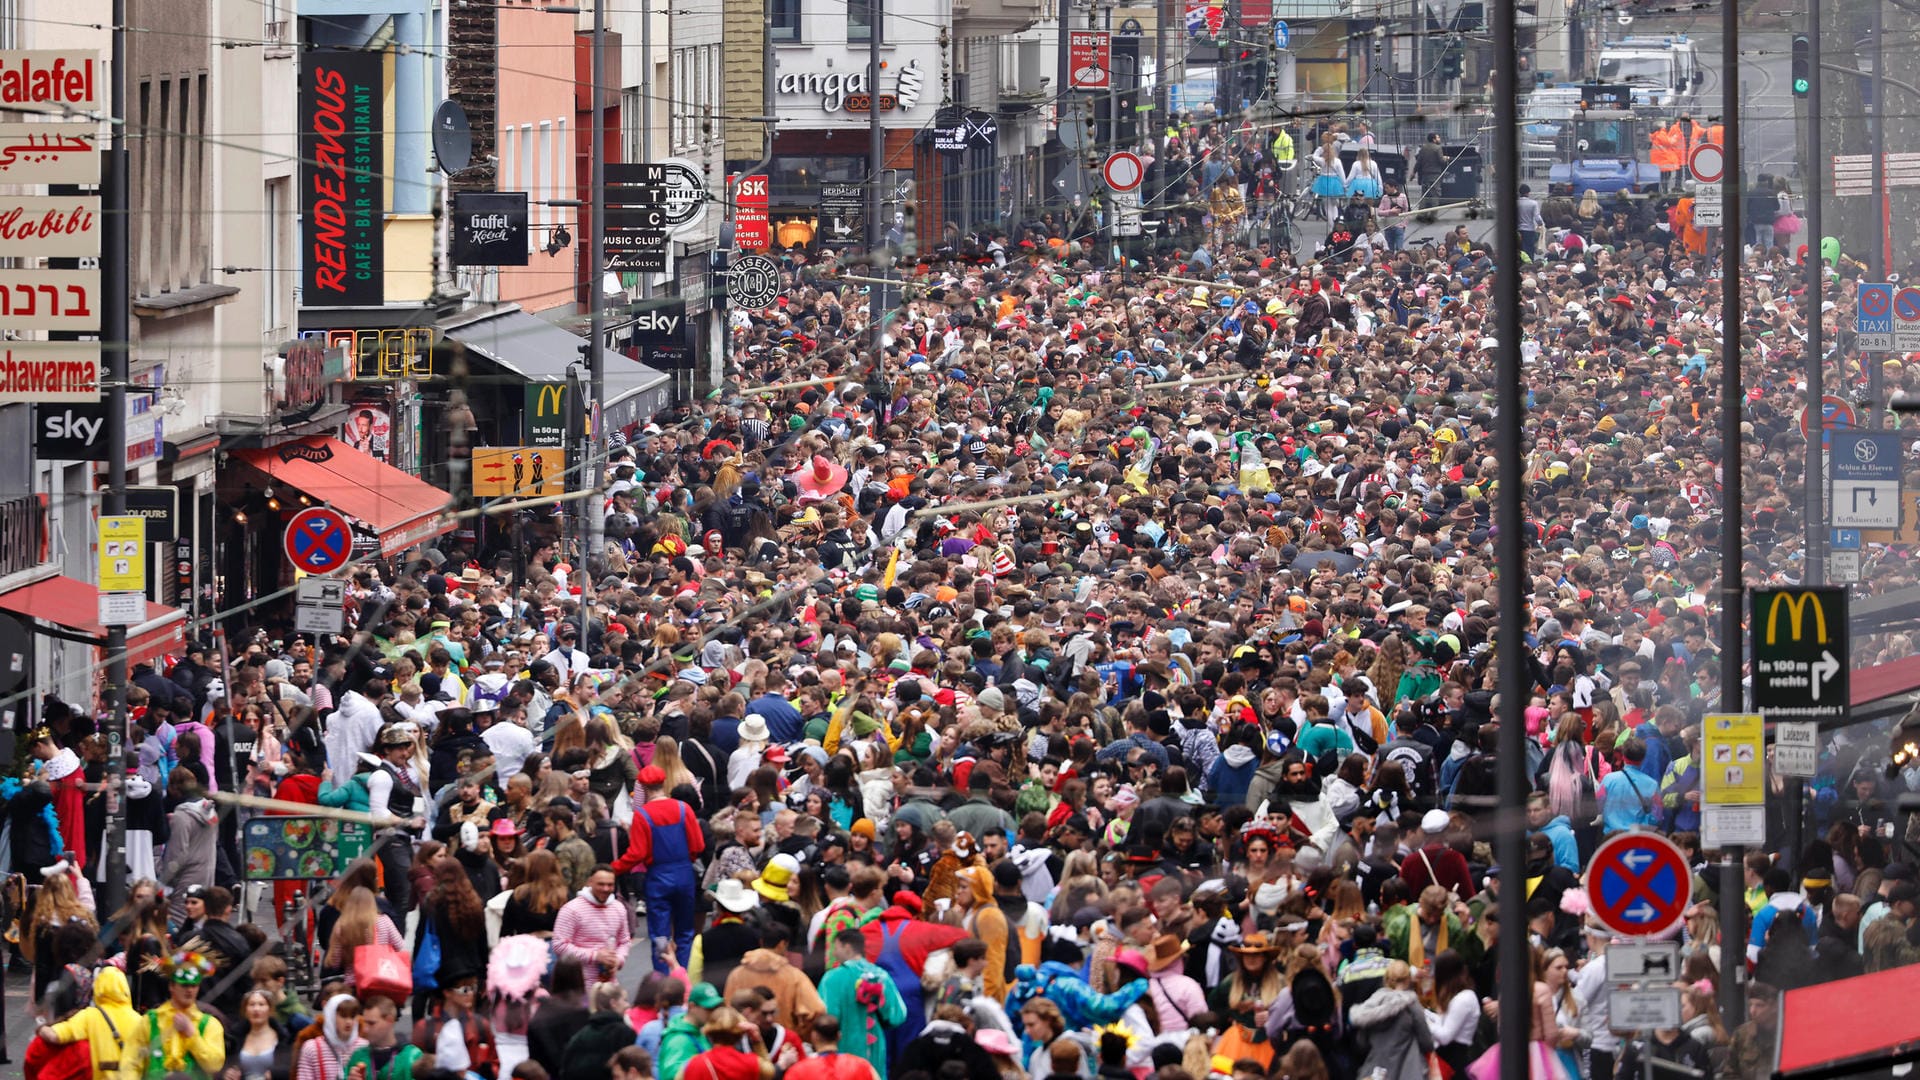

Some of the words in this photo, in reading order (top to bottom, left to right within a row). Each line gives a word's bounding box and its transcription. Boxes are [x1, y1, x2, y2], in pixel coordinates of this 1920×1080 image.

[775, 73, 871, 113] anga
[851, 96, 891, 109] DÖER
[354, 84, 371, 183] RESTAURANT
[0, 133, 92, 171] حبيبي
[314, 66, 347, 293] RENDEZVOUS
[649, 167, 662, 180] M
[650, 190, 660, 202] T
[666, 190, 704, 199] RTIER
[354, 198, 371, 227] BAR
[649, 213, 660, 225] C
[0, 206, 93, 240] Habibi
[471, 214, 510, 230] Gaffel
[635, 237, 662, 245] CLUB
[354, 244, 371, 280] CAFÉ
[743, 273, 763, 292] K&B
[730, 287, 776, 307] 9383320
[638, 310, 679, 335] sky
[1861, 320, 1889, 331] TAXI
[45, 410, 104, 446] sky
[125, 509, 168, 518] OLOURS
[1759, 660, 1771, 672] in
[1773, 660, 1795, 672] 100
[1796, 662, 1808, 672] m
[1769, 675, 1808, 687] rechts
[234, 742, 252, 752] OLICE
